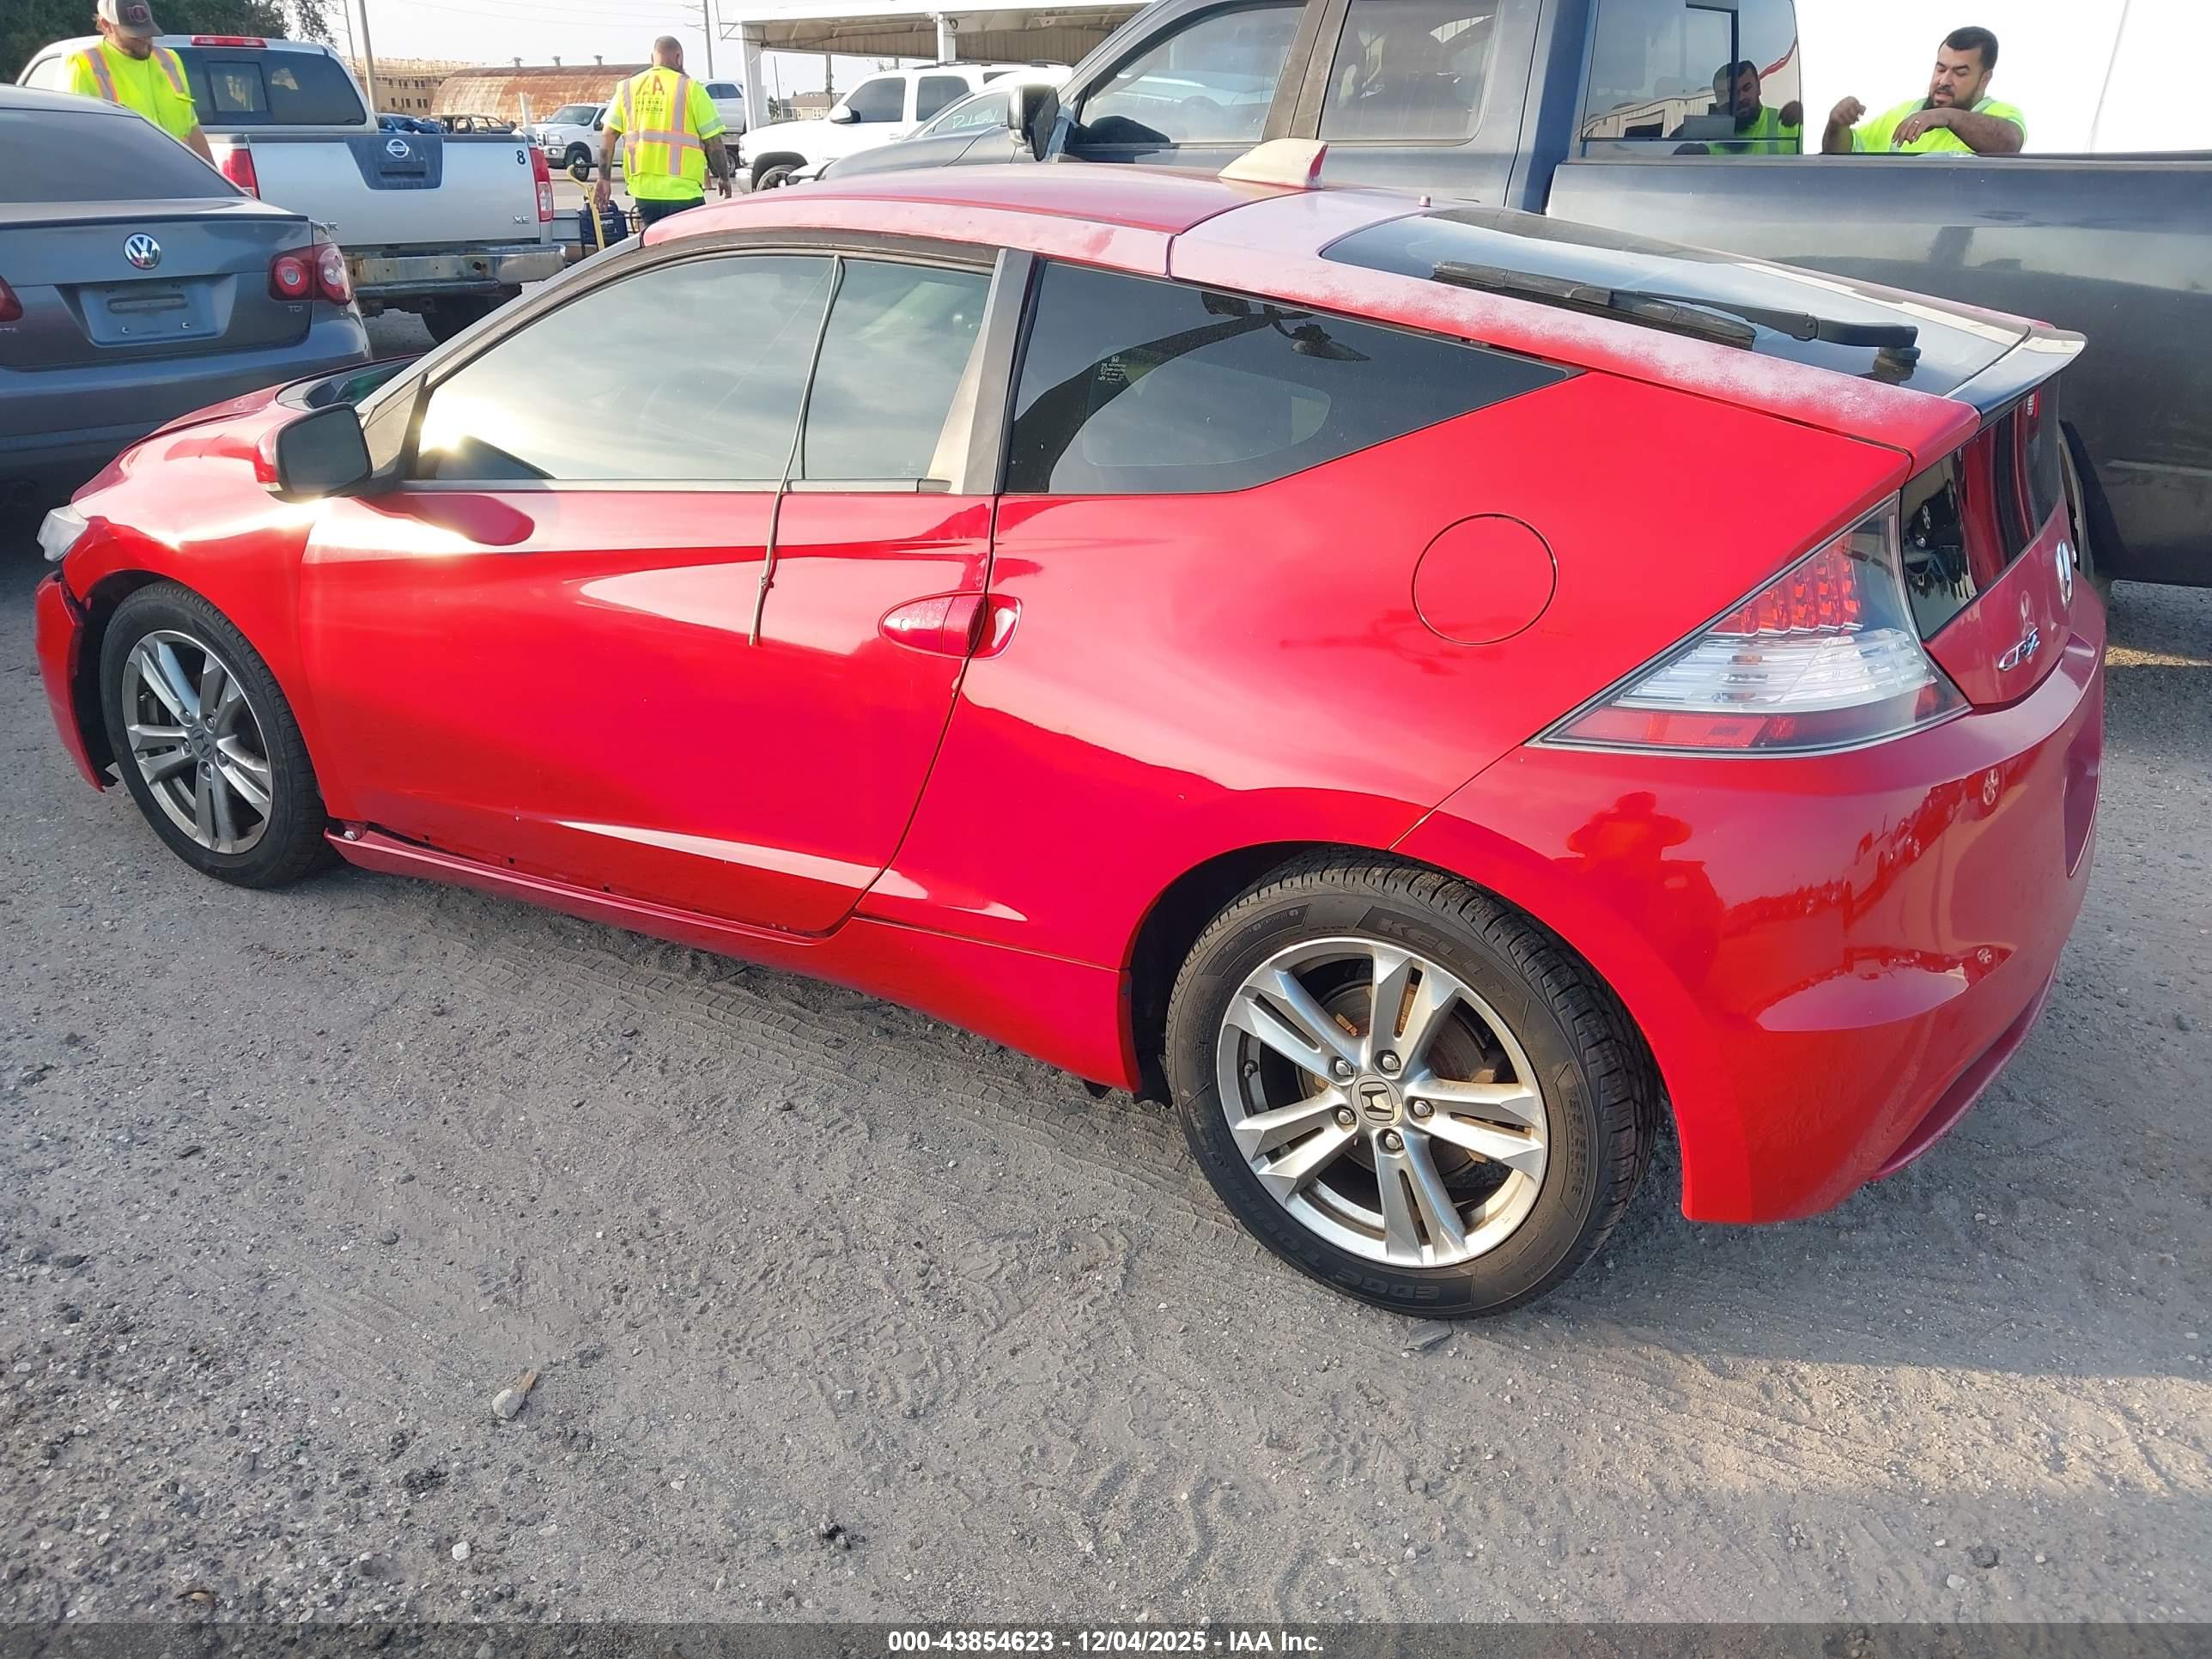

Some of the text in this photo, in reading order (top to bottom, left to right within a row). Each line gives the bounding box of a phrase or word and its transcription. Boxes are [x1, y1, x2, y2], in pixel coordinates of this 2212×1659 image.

[516, 149, 526, 165] 8
[1376, 915, 1516, 1006] KELLY
[1335, 1267, 1442, 1300] EDGE
